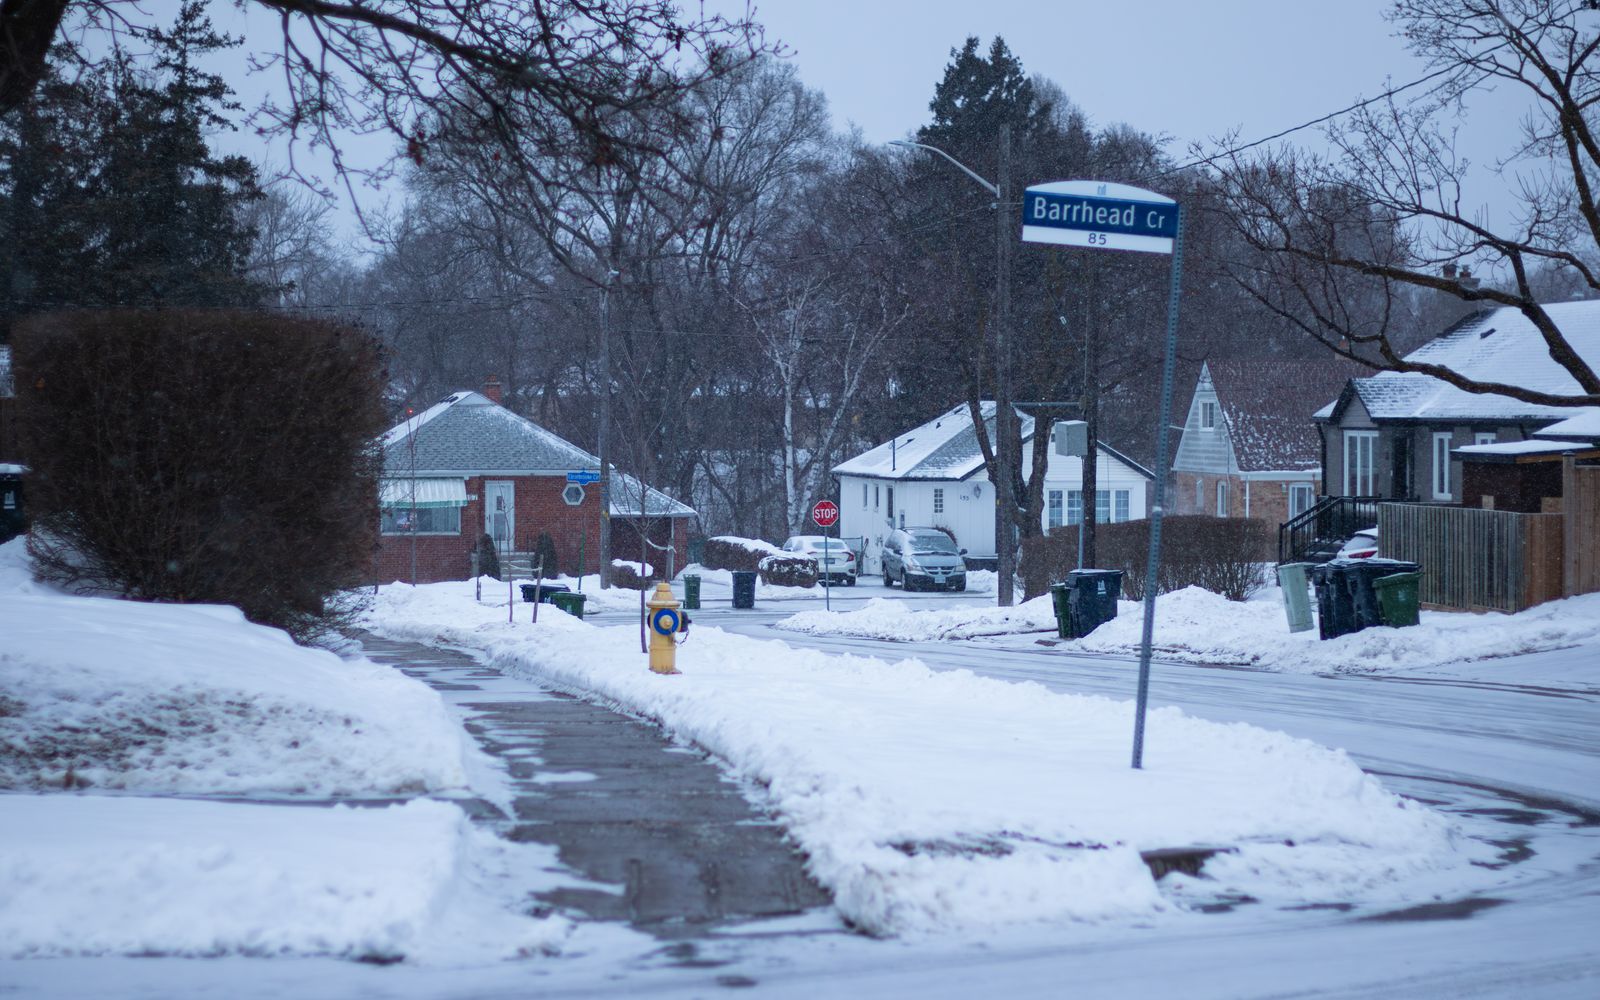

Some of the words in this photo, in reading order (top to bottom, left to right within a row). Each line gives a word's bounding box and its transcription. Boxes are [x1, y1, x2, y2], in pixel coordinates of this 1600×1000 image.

[1033, 196, 1136, 227] Barrhead
[1146, 210, 1166, 229] Cr
[1088, 232, 1107, 246] 85
[814, 508, 837, 519] STOP
